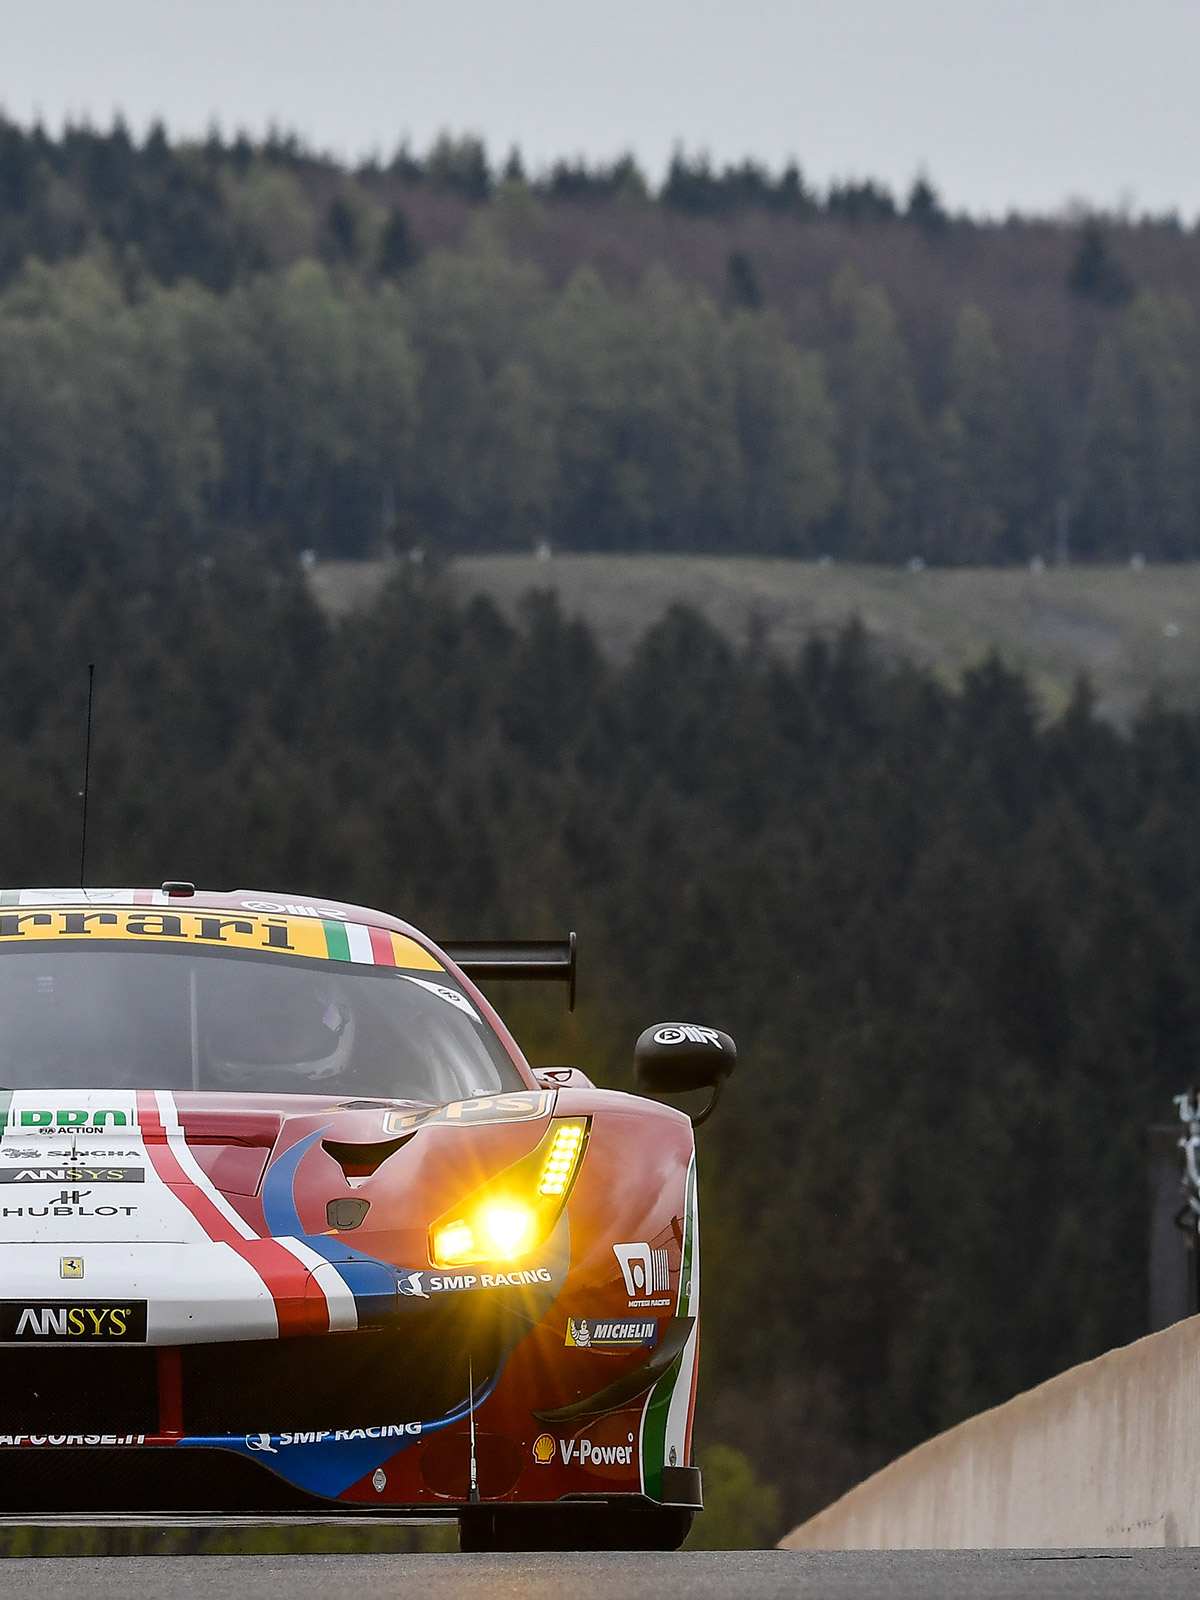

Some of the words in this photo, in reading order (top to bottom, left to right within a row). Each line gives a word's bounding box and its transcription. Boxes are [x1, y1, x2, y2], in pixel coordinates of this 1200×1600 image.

[57, 1126, 104, 1134] ACTION
[47, 1150, 141, 1158] SINGHA
[13, 1169, 125, 1180] ANSYS
[2, 1206, 138, 1217] HUBLOT
[429, 1275, 477, 1291] SMP
[480, 1268, 552, 1287] RACING
[15, 1308, 127, 1335] ANSYS
[593, 1323, 655, 1339] MICHELIN
[279, 1431, 330, 1446] SMP
[334, 1421, 422, 1442] RACING
[559, 1439, 633, 1465] V-Power
